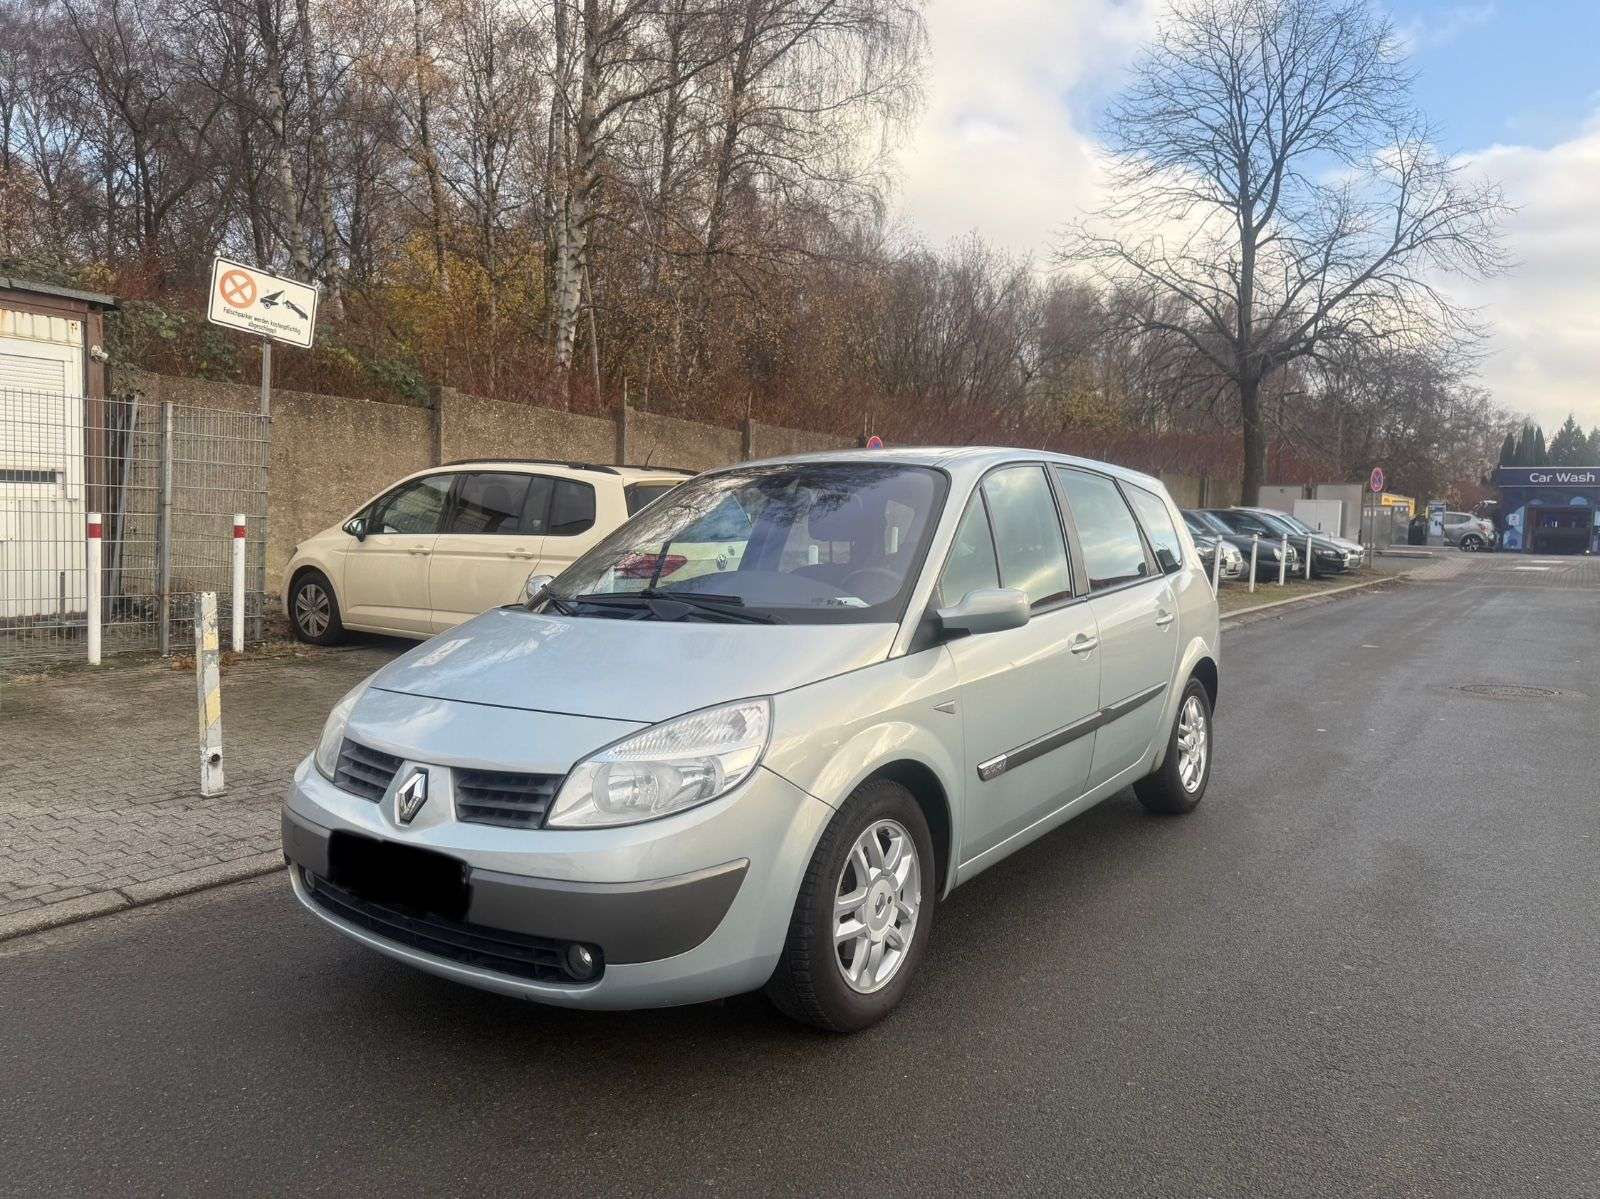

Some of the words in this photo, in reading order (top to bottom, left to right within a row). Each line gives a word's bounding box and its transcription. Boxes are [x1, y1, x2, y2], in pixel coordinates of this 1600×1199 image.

[253, 316, 270, 326] werden
[1529, 472, 1553, 483] Car
[1556, 472, 1596, 483] Wash
